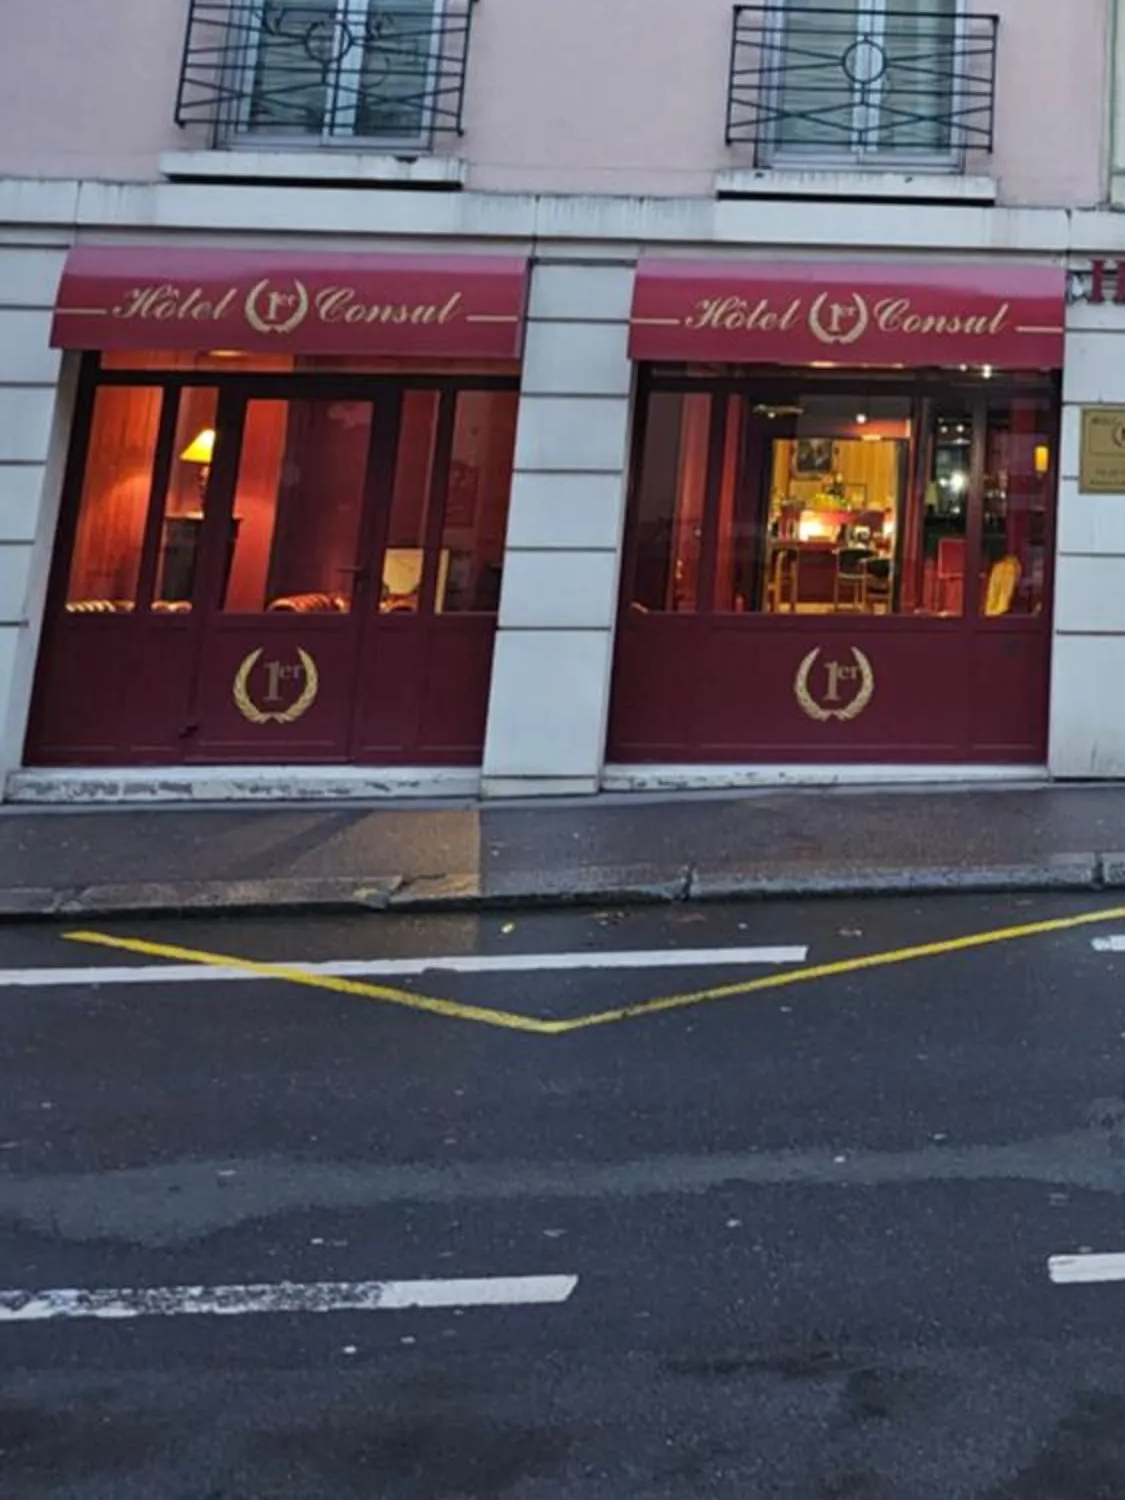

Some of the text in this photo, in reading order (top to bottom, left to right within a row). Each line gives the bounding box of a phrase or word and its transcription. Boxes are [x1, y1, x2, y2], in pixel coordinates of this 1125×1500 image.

[111, 284, 238, 320] Hôtel
[315, 285, 462, 325] Consul
[684, 295, 802, 331] Hôtel
[873, 298, 1010, 335] Consul
